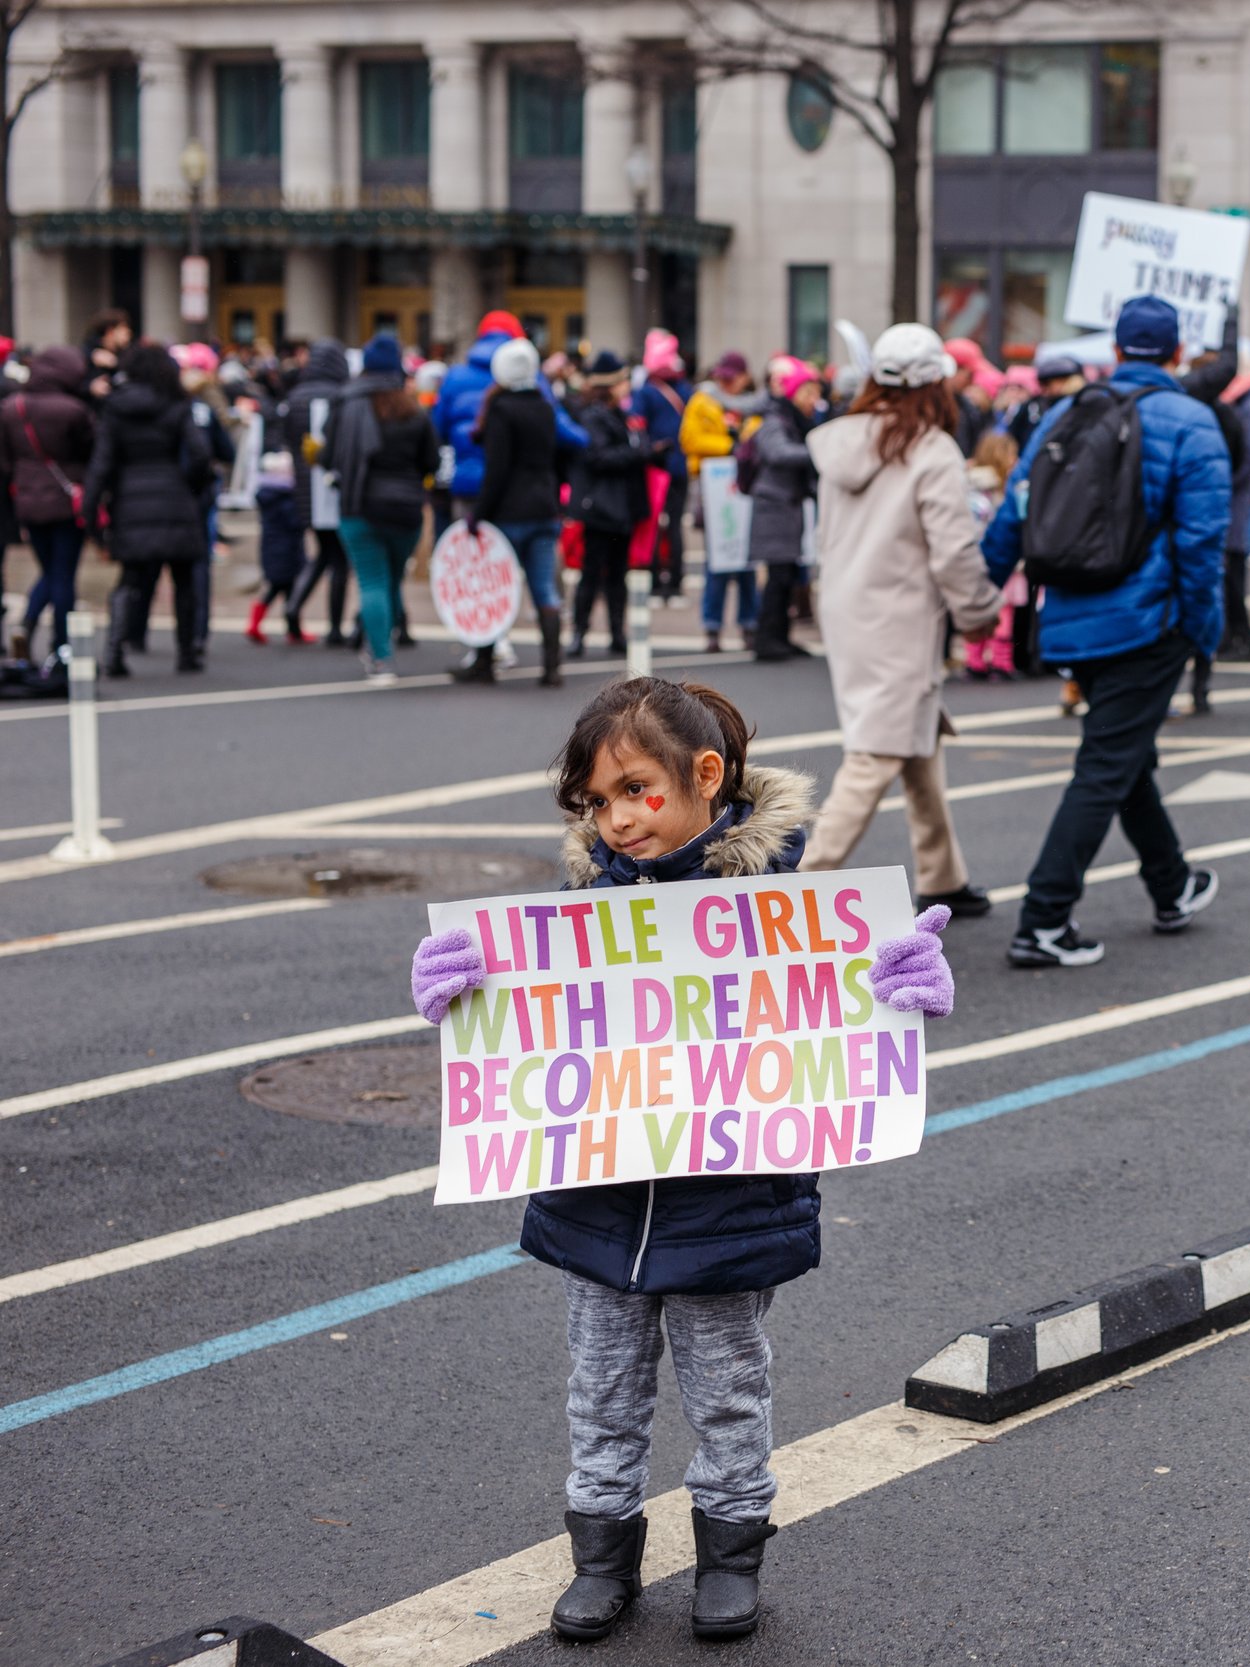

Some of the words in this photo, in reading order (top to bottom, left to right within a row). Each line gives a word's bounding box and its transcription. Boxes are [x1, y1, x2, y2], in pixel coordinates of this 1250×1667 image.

[475, 898, 662, 974] LITTLE
[693, 888, 870, 959] GIRLS
[448, 981, 608, 1055] WITH
[633, 958, 873, 1043] DREAMS
[447, 1045, 674, 1127] BECOME
[687, 1029, 918, 1106] WOMEN
[465, 1117, 618, 1195] WITH
[644, 1101, 876, 1173] VISION!
